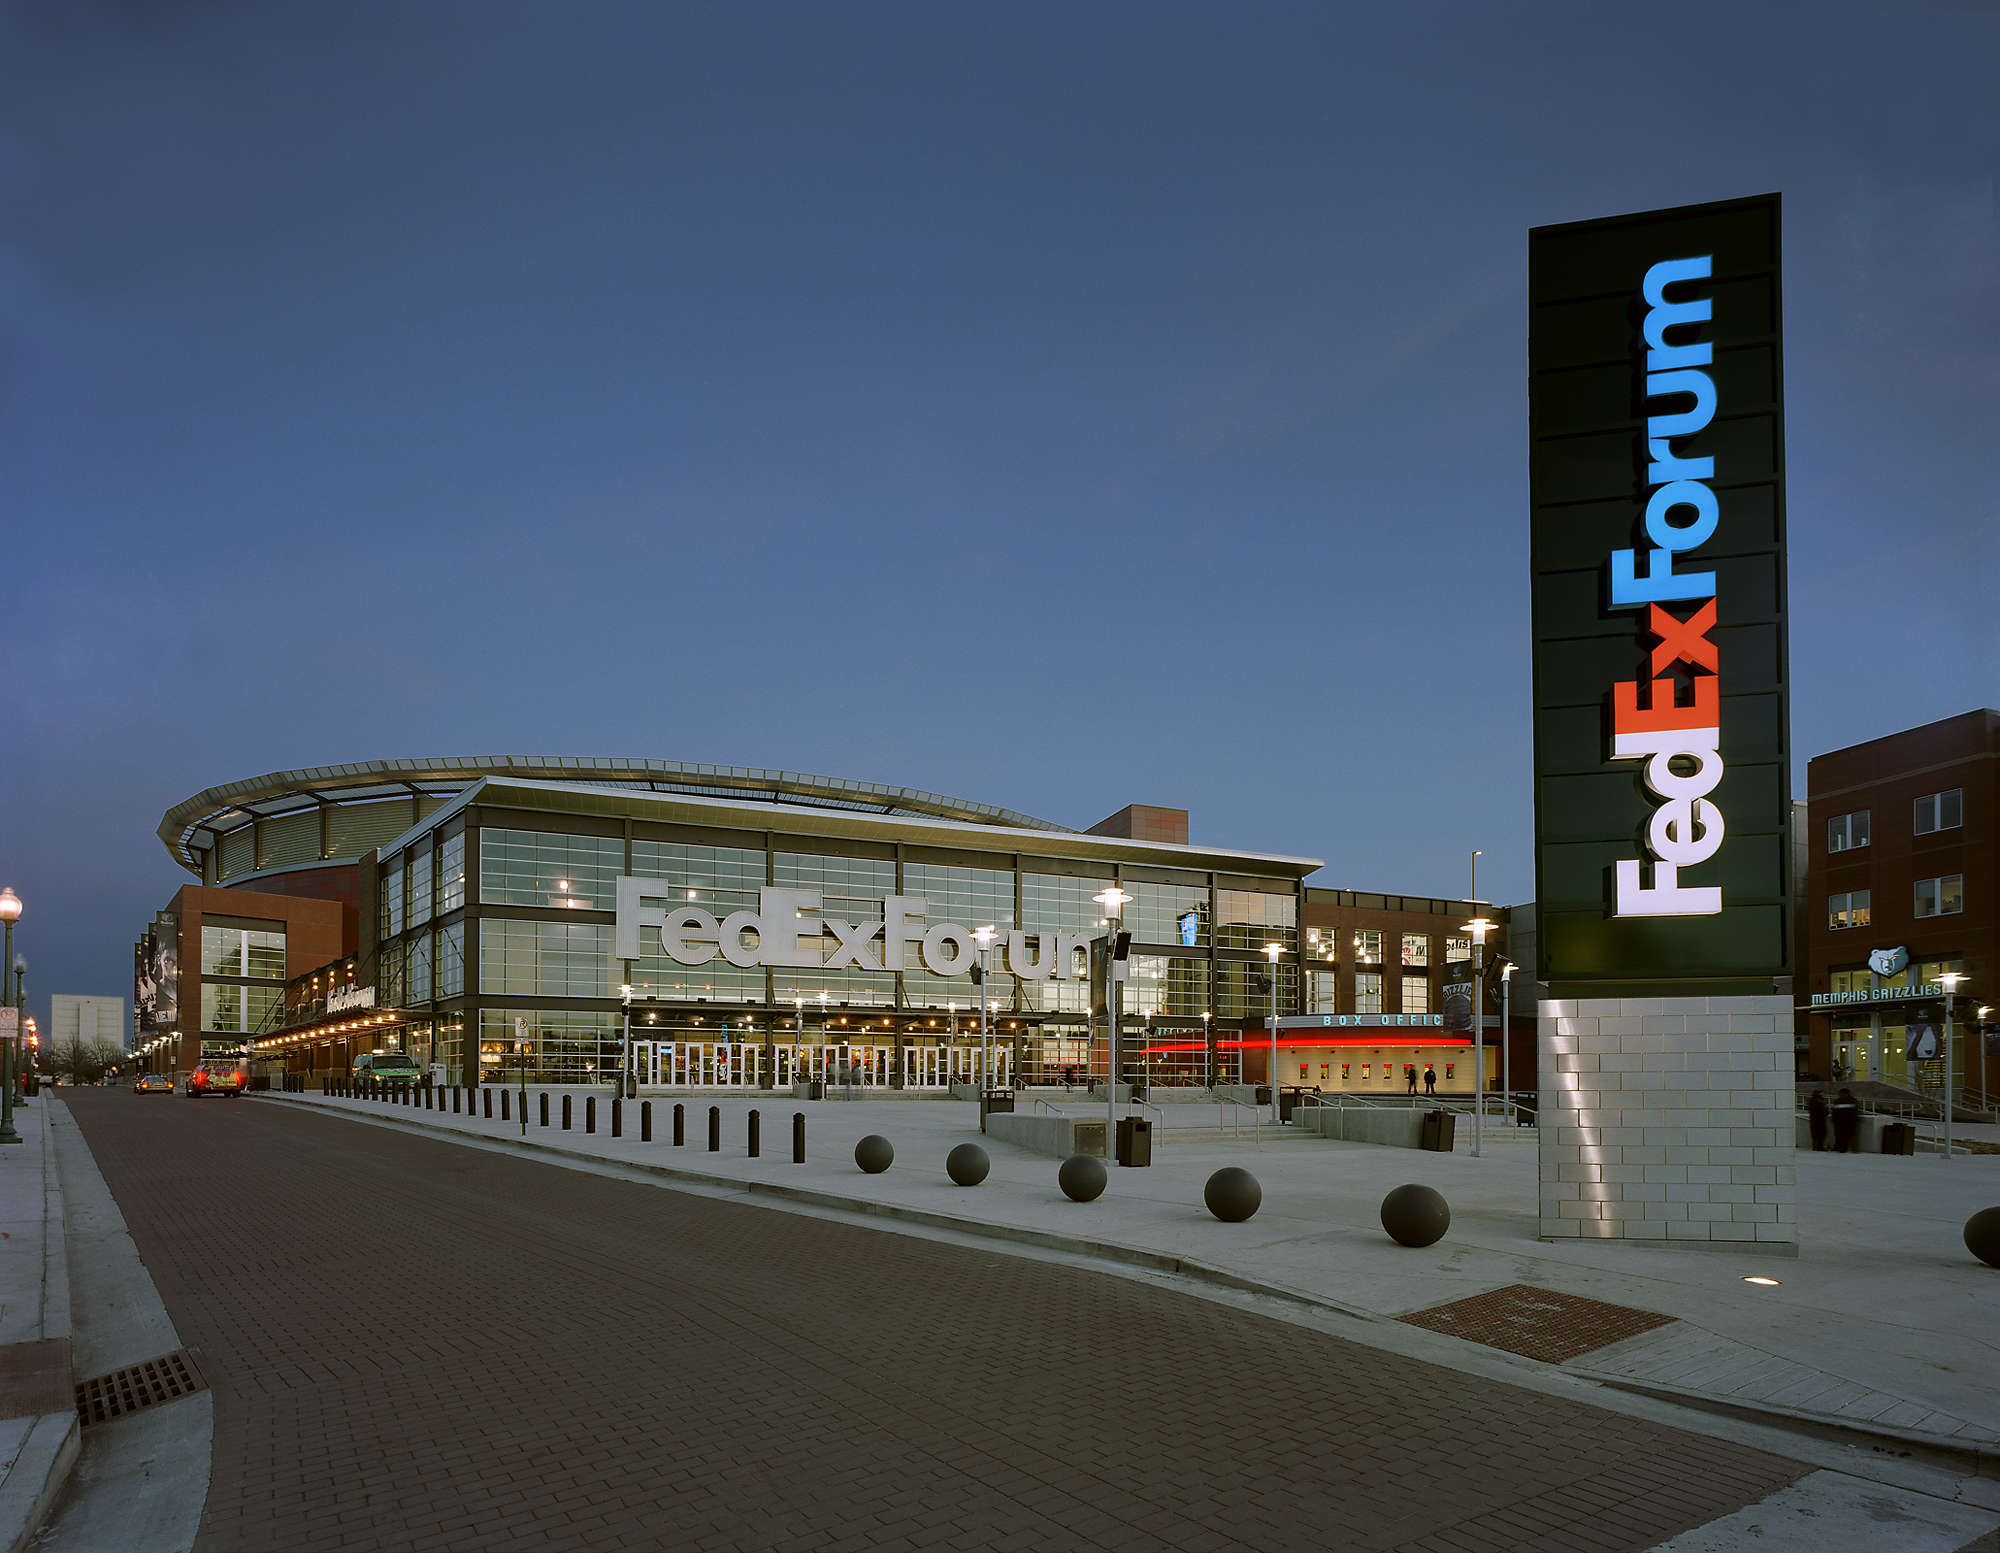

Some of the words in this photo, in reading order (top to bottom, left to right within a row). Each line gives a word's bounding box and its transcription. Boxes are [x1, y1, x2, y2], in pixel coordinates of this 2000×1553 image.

[1610, 255, 1725, 917] FedExForum
[1811, 989, 1868, 1006] MEMPHIS
[1871, 983, 1942, 1000] GRIZZLIES
[1323, 1015, 1362, 1026] BOX
[1381, 1014, 1441, 1026] OFFIC
